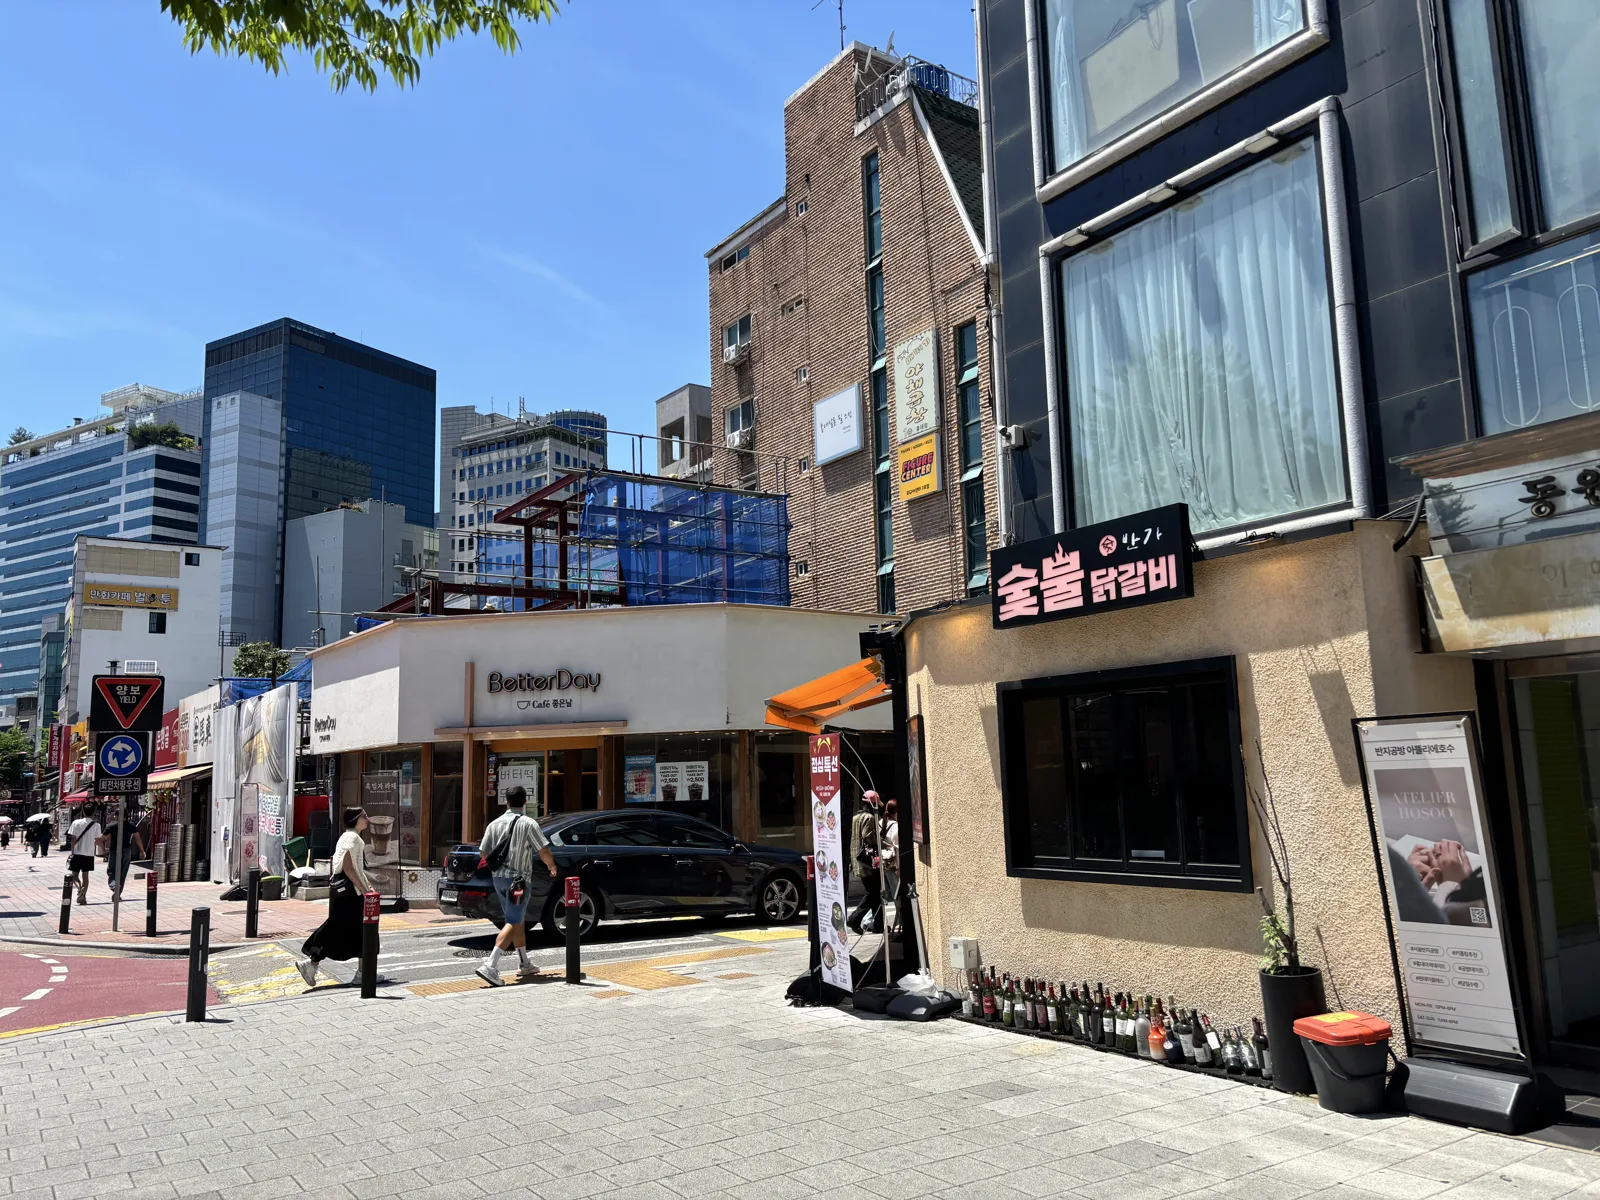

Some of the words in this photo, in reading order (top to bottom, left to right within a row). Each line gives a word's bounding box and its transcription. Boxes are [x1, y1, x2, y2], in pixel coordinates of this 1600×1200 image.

[905, 363, 928, 426] 야채곱창
[903, 452, 934, 472] FIGURE
[901, 464, 932, 482] CENTER
[997, 541, 1085, 622] 숯불
[1090, 553, 1178, 604] 닭갈비
[90, 589, 131, 602] 만화카페
[487, 668, 601, 693] BetterDay
[116, 685, 140, 695] 양보
[120, 696, 136, 704] YIELD
[532, 700, 550, 709] Café
[552, 698, 573, 708] 좋은날
[1375, 745, 1406, 756] 반지공방
[1406, 743, 1455, 755] 아뜰리에호수
[501, 769, 533, 780] 버터떡
[811, 755, 838, 782] 점심특선
[101, 780, 140, 790] 회전차량우선
[1393, 792, 1456, 804] ATELIER
[1399, 807, 1453, 819] HOSOO
